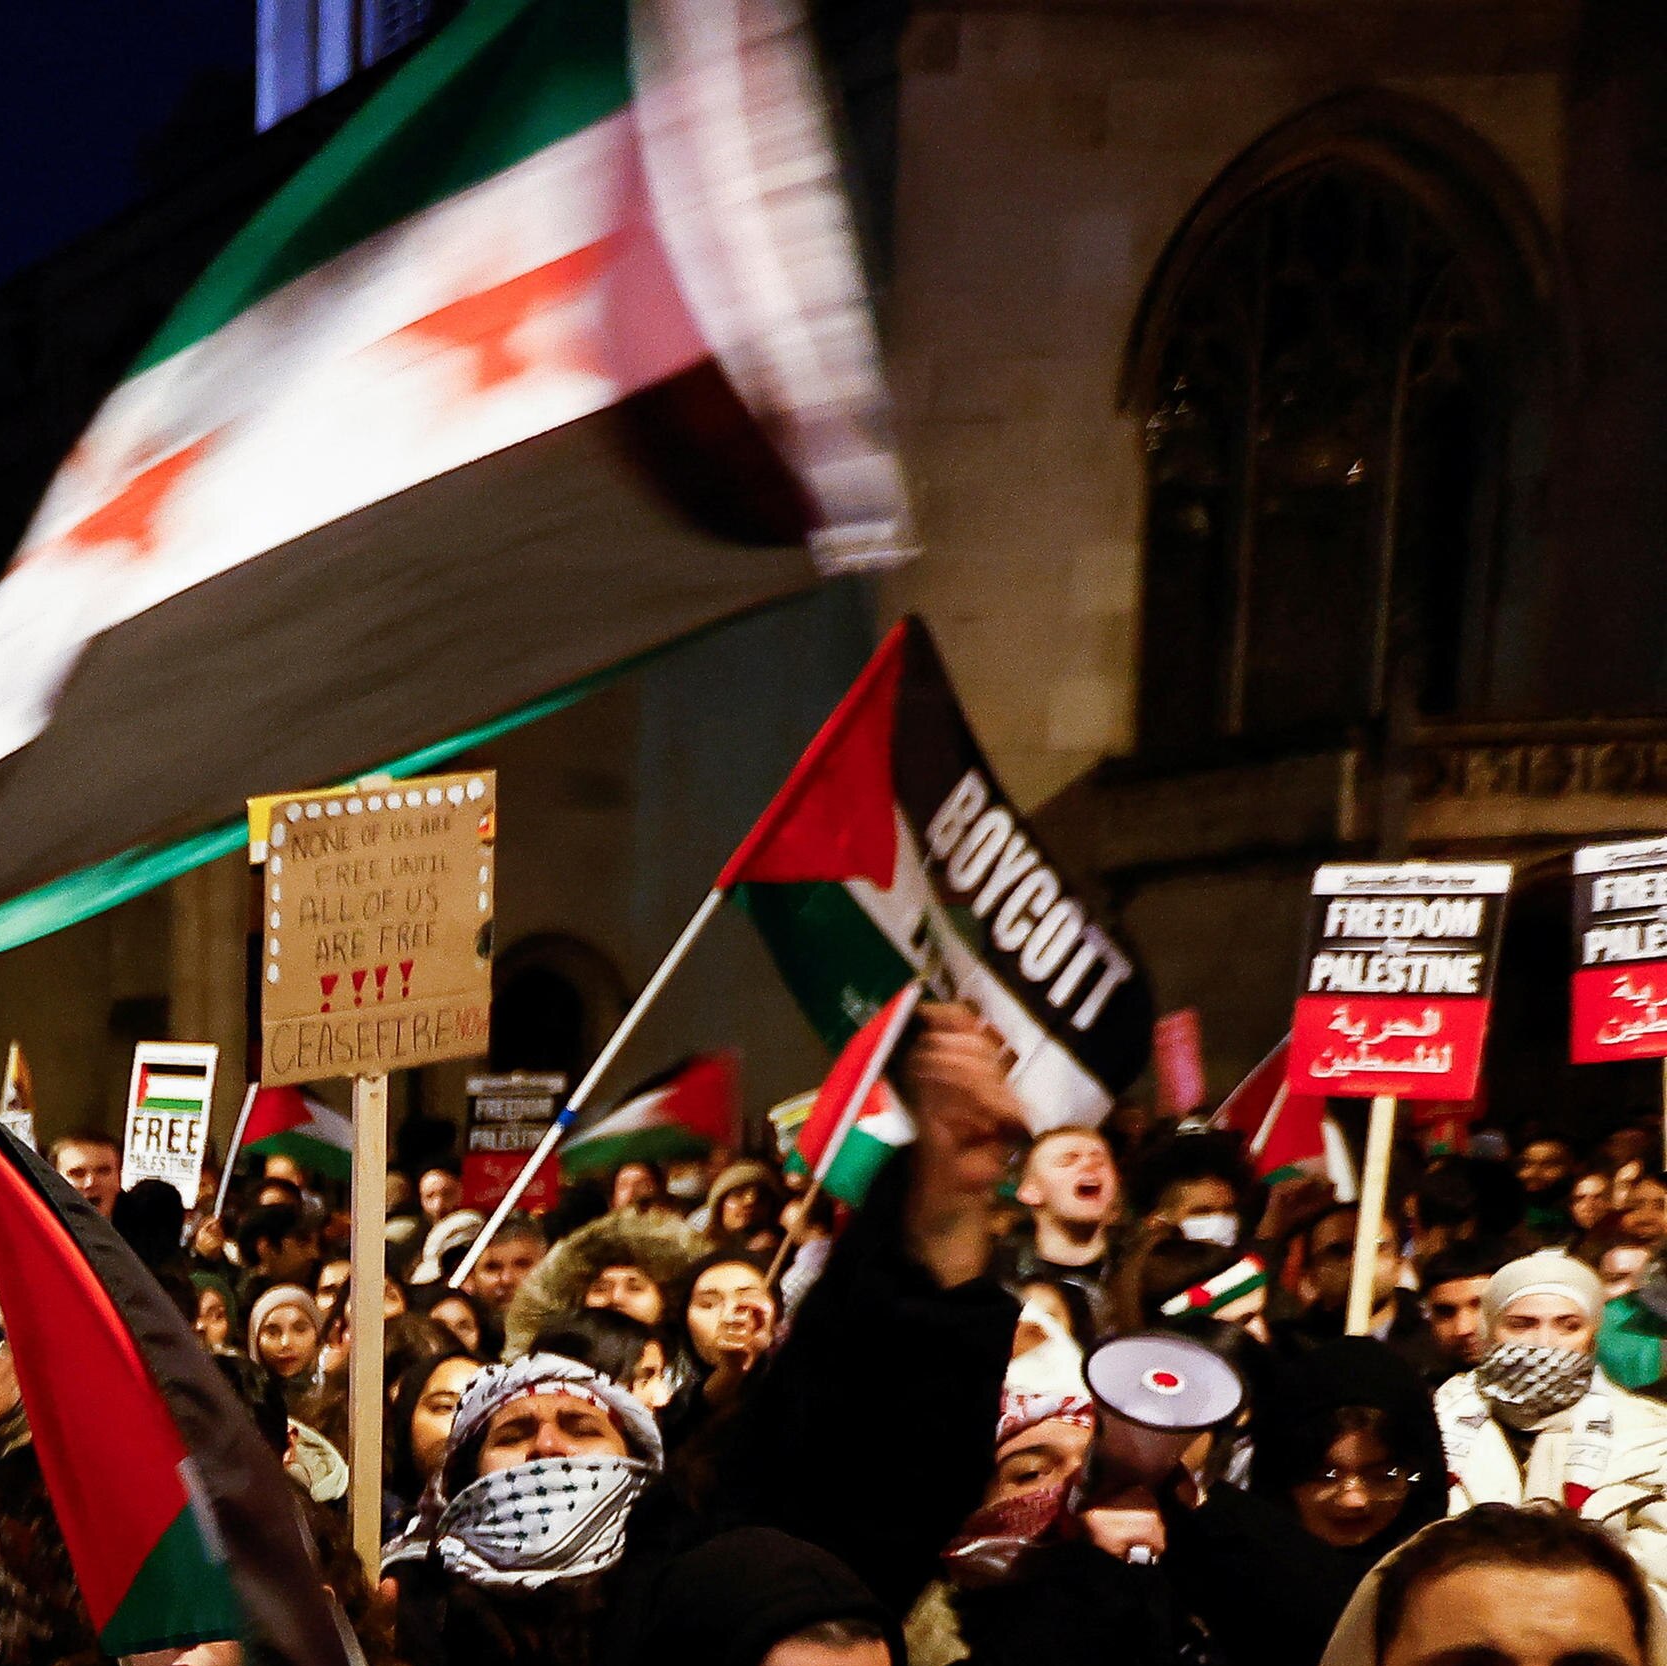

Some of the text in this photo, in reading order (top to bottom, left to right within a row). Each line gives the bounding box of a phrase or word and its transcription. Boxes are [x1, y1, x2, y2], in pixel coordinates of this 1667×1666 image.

[300, 883, 439, 928] ALL OF US
[925, 770, 1133, 1032] BOYCOTT
[1323, 898, 1484, 938] FREEDOM
[317, 920, 438, 964] ARE FREE
[1308, 952, 1484, 993] PALESTINE
[130, 1115, 202, 1155] FREE
